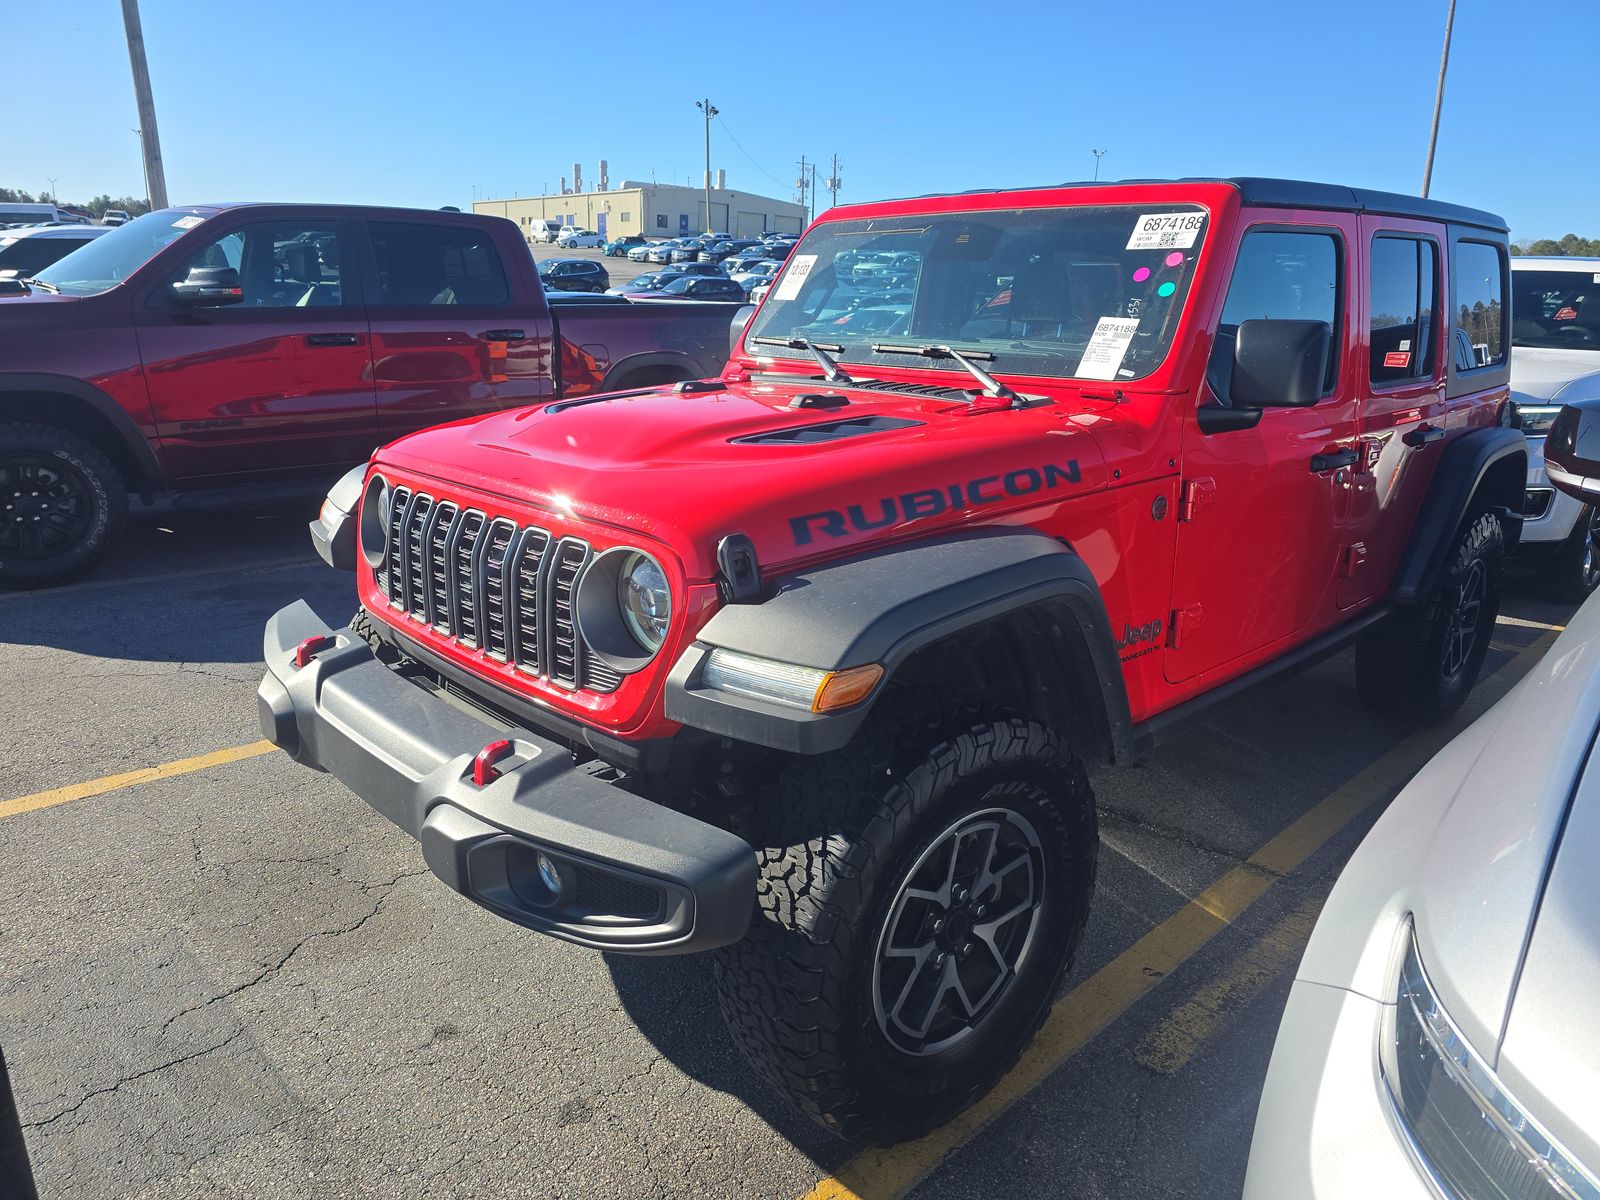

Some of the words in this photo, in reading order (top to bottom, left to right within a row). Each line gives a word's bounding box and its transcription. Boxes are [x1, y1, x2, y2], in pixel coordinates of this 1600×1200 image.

[1144, 216, 1204, 231] 6874188
[1097, 323, 1137, 334] 6874188
[788, 459, 1083, 547] RUBICON
[1115, 619, 1162, 649] Jeep
[1120, 647, 1153, 662] RANGLER
